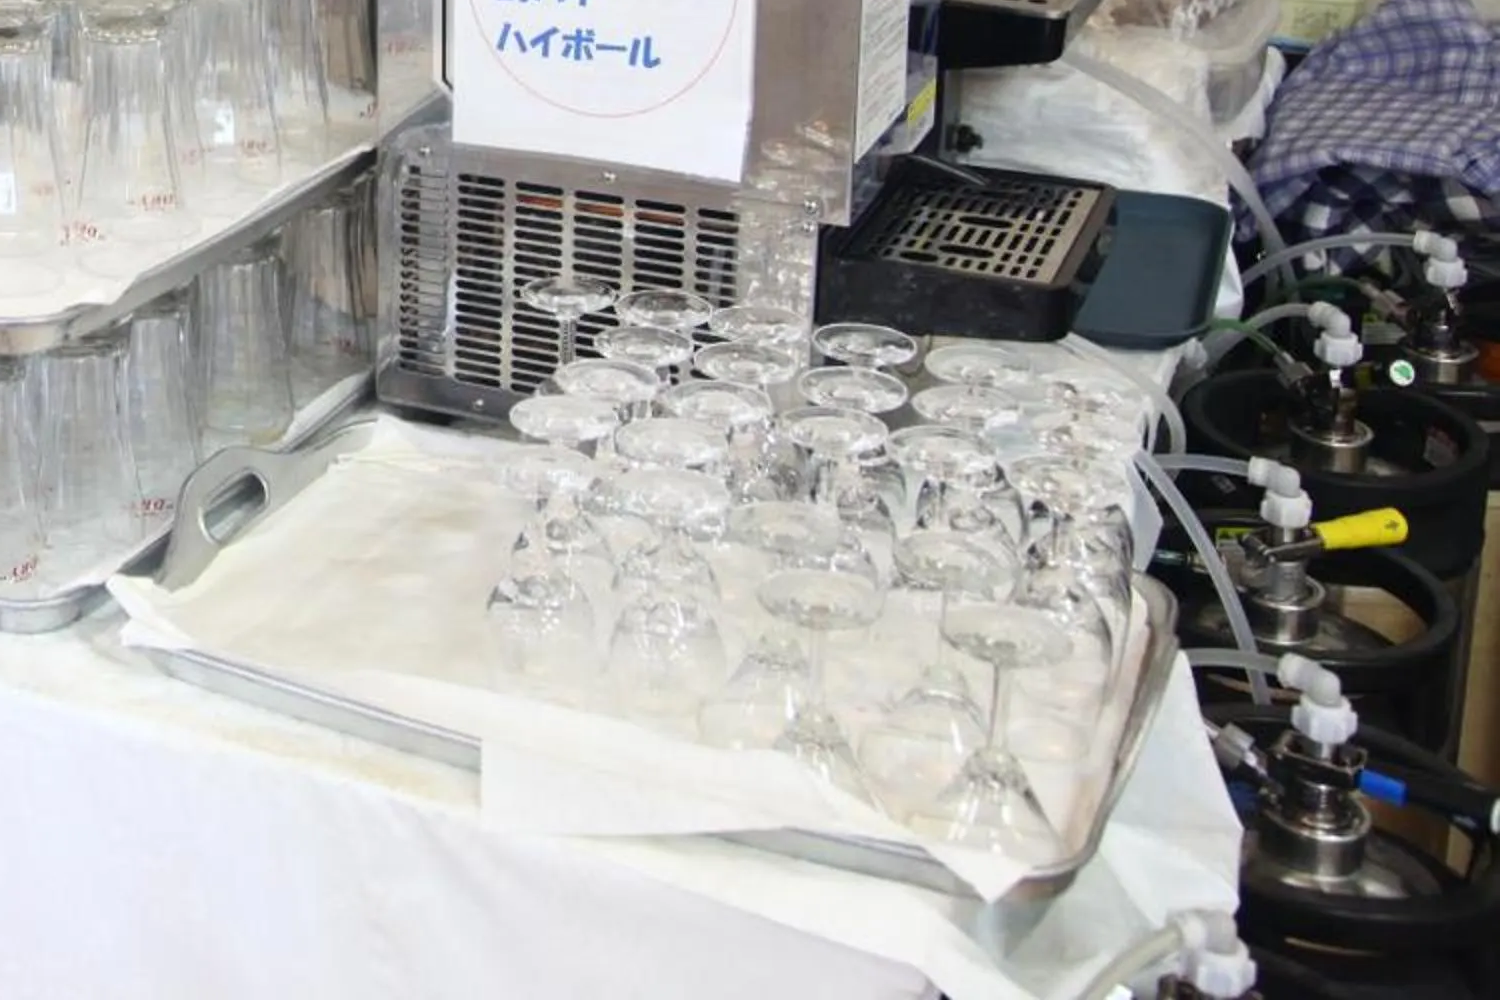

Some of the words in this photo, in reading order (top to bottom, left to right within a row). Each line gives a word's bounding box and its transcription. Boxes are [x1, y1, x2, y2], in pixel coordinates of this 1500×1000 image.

[496, 22, 661, 69] ハイボール
